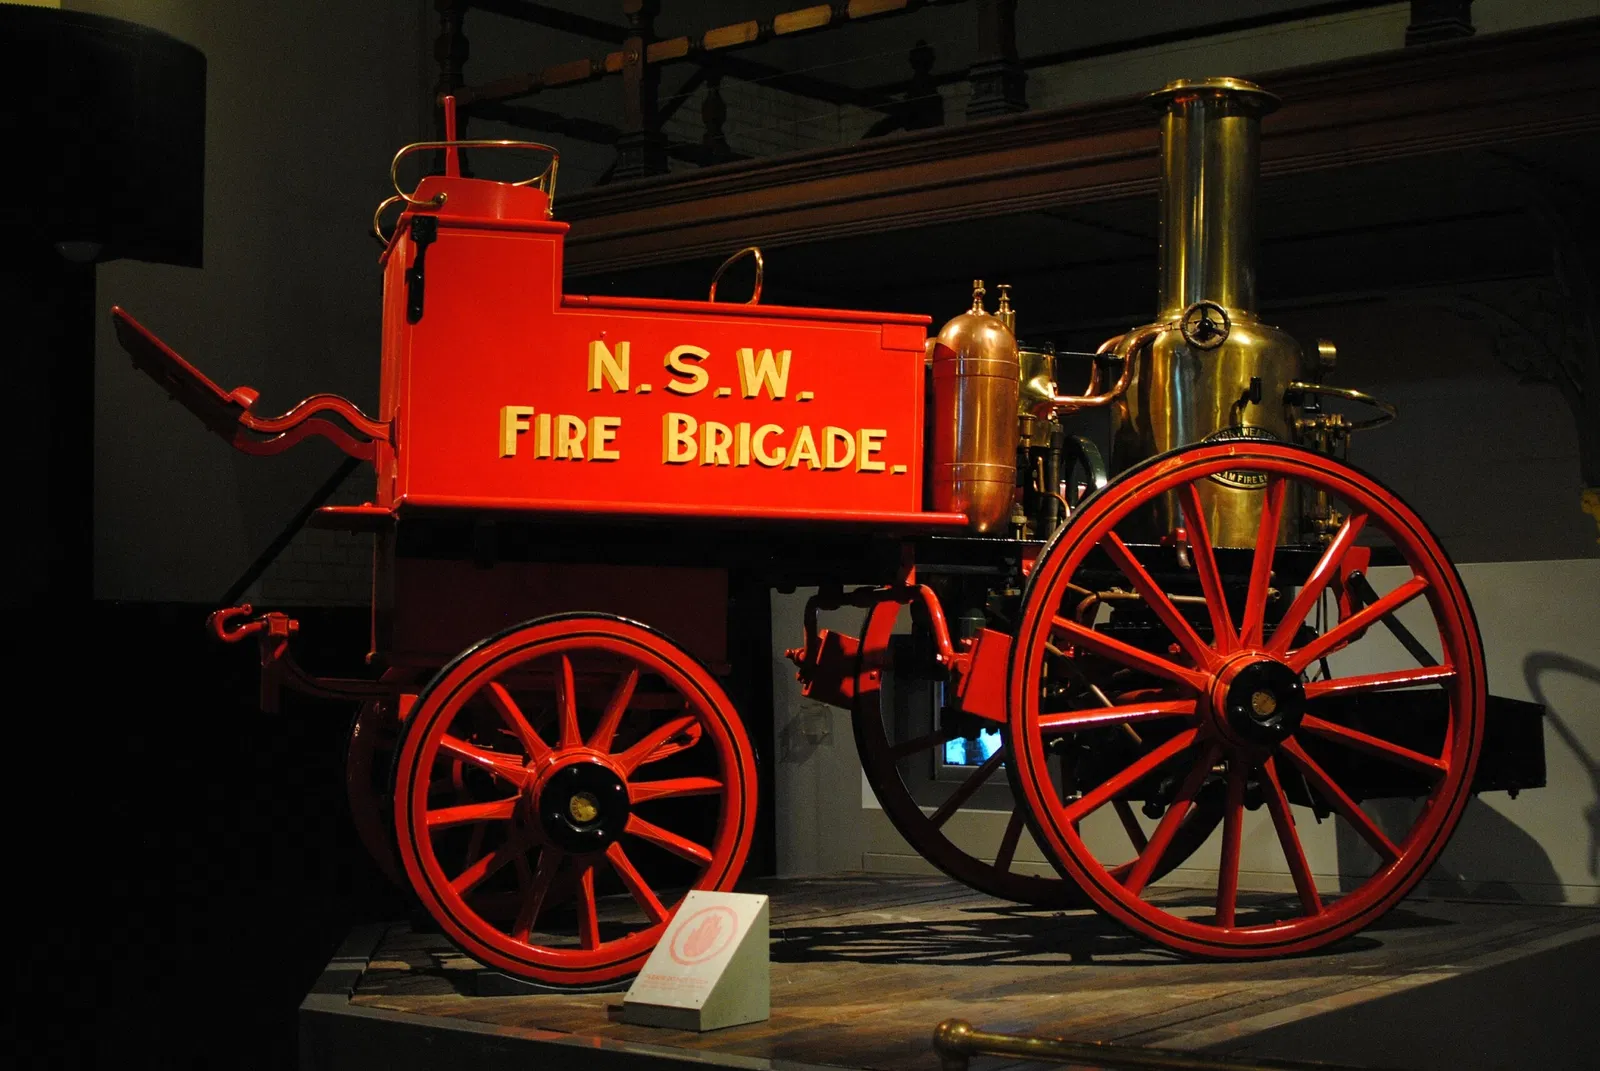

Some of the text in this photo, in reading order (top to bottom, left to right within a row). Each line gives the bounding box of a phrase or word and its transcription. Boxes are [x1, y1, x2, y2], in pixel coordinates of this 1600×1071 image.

[499, 405, 908, 475] FIRE BRIGADE.
[1237, 474, 1258, 484] FIRE
